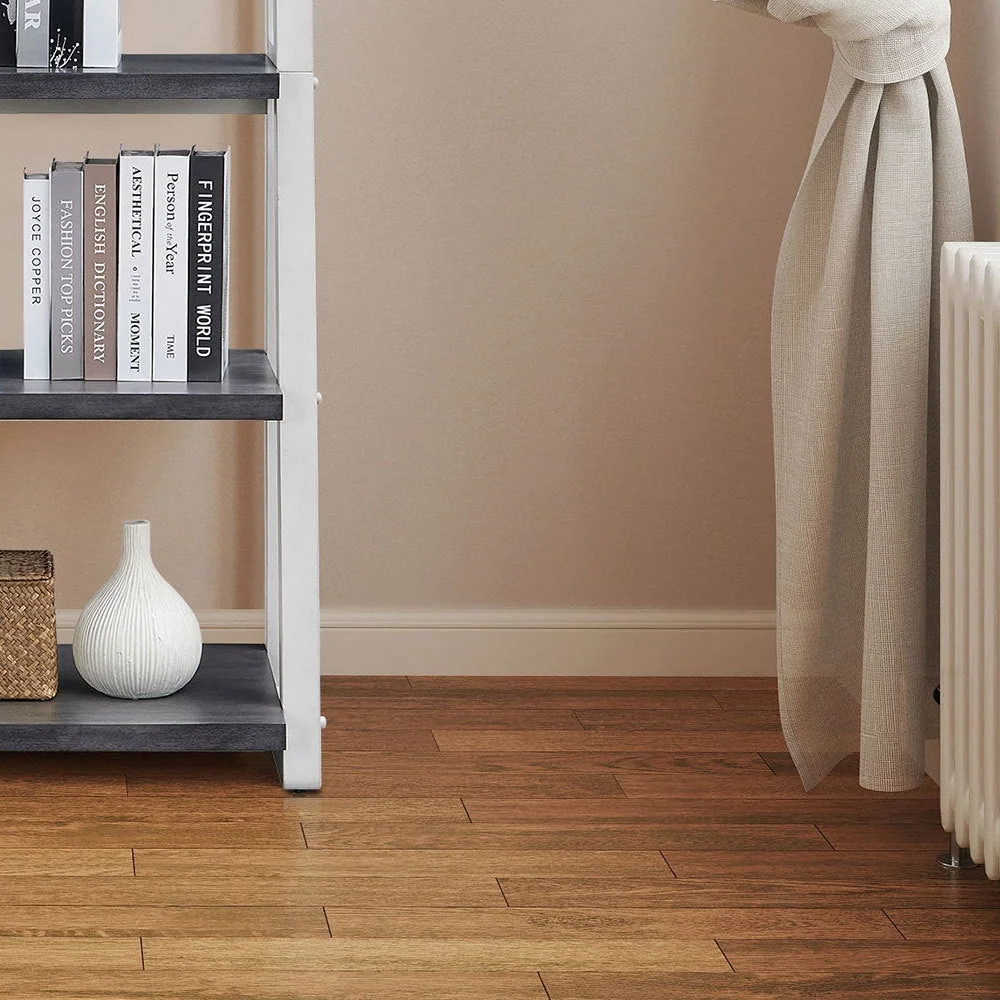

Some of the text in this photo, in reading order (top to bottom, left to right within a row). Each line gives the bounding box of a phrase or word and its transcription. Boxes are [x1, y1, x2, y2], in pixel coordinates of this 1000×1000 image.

[31, 196, 41, 305] JOYCE COPPER
[131, 166, 142, 258] AESTHETICAL
[165, 173, 179, 275] Person of the Year
[60, 200, 73, 355] FASHION TOP PICKS
[93, 184, 106, 364] ENGLISH DICTIONARY
[196, 180, 213, 358] FINGERPRINT WORLD
[130, 312, 140, 372] MOMENT
[166, 334, 175, 359] TIME
